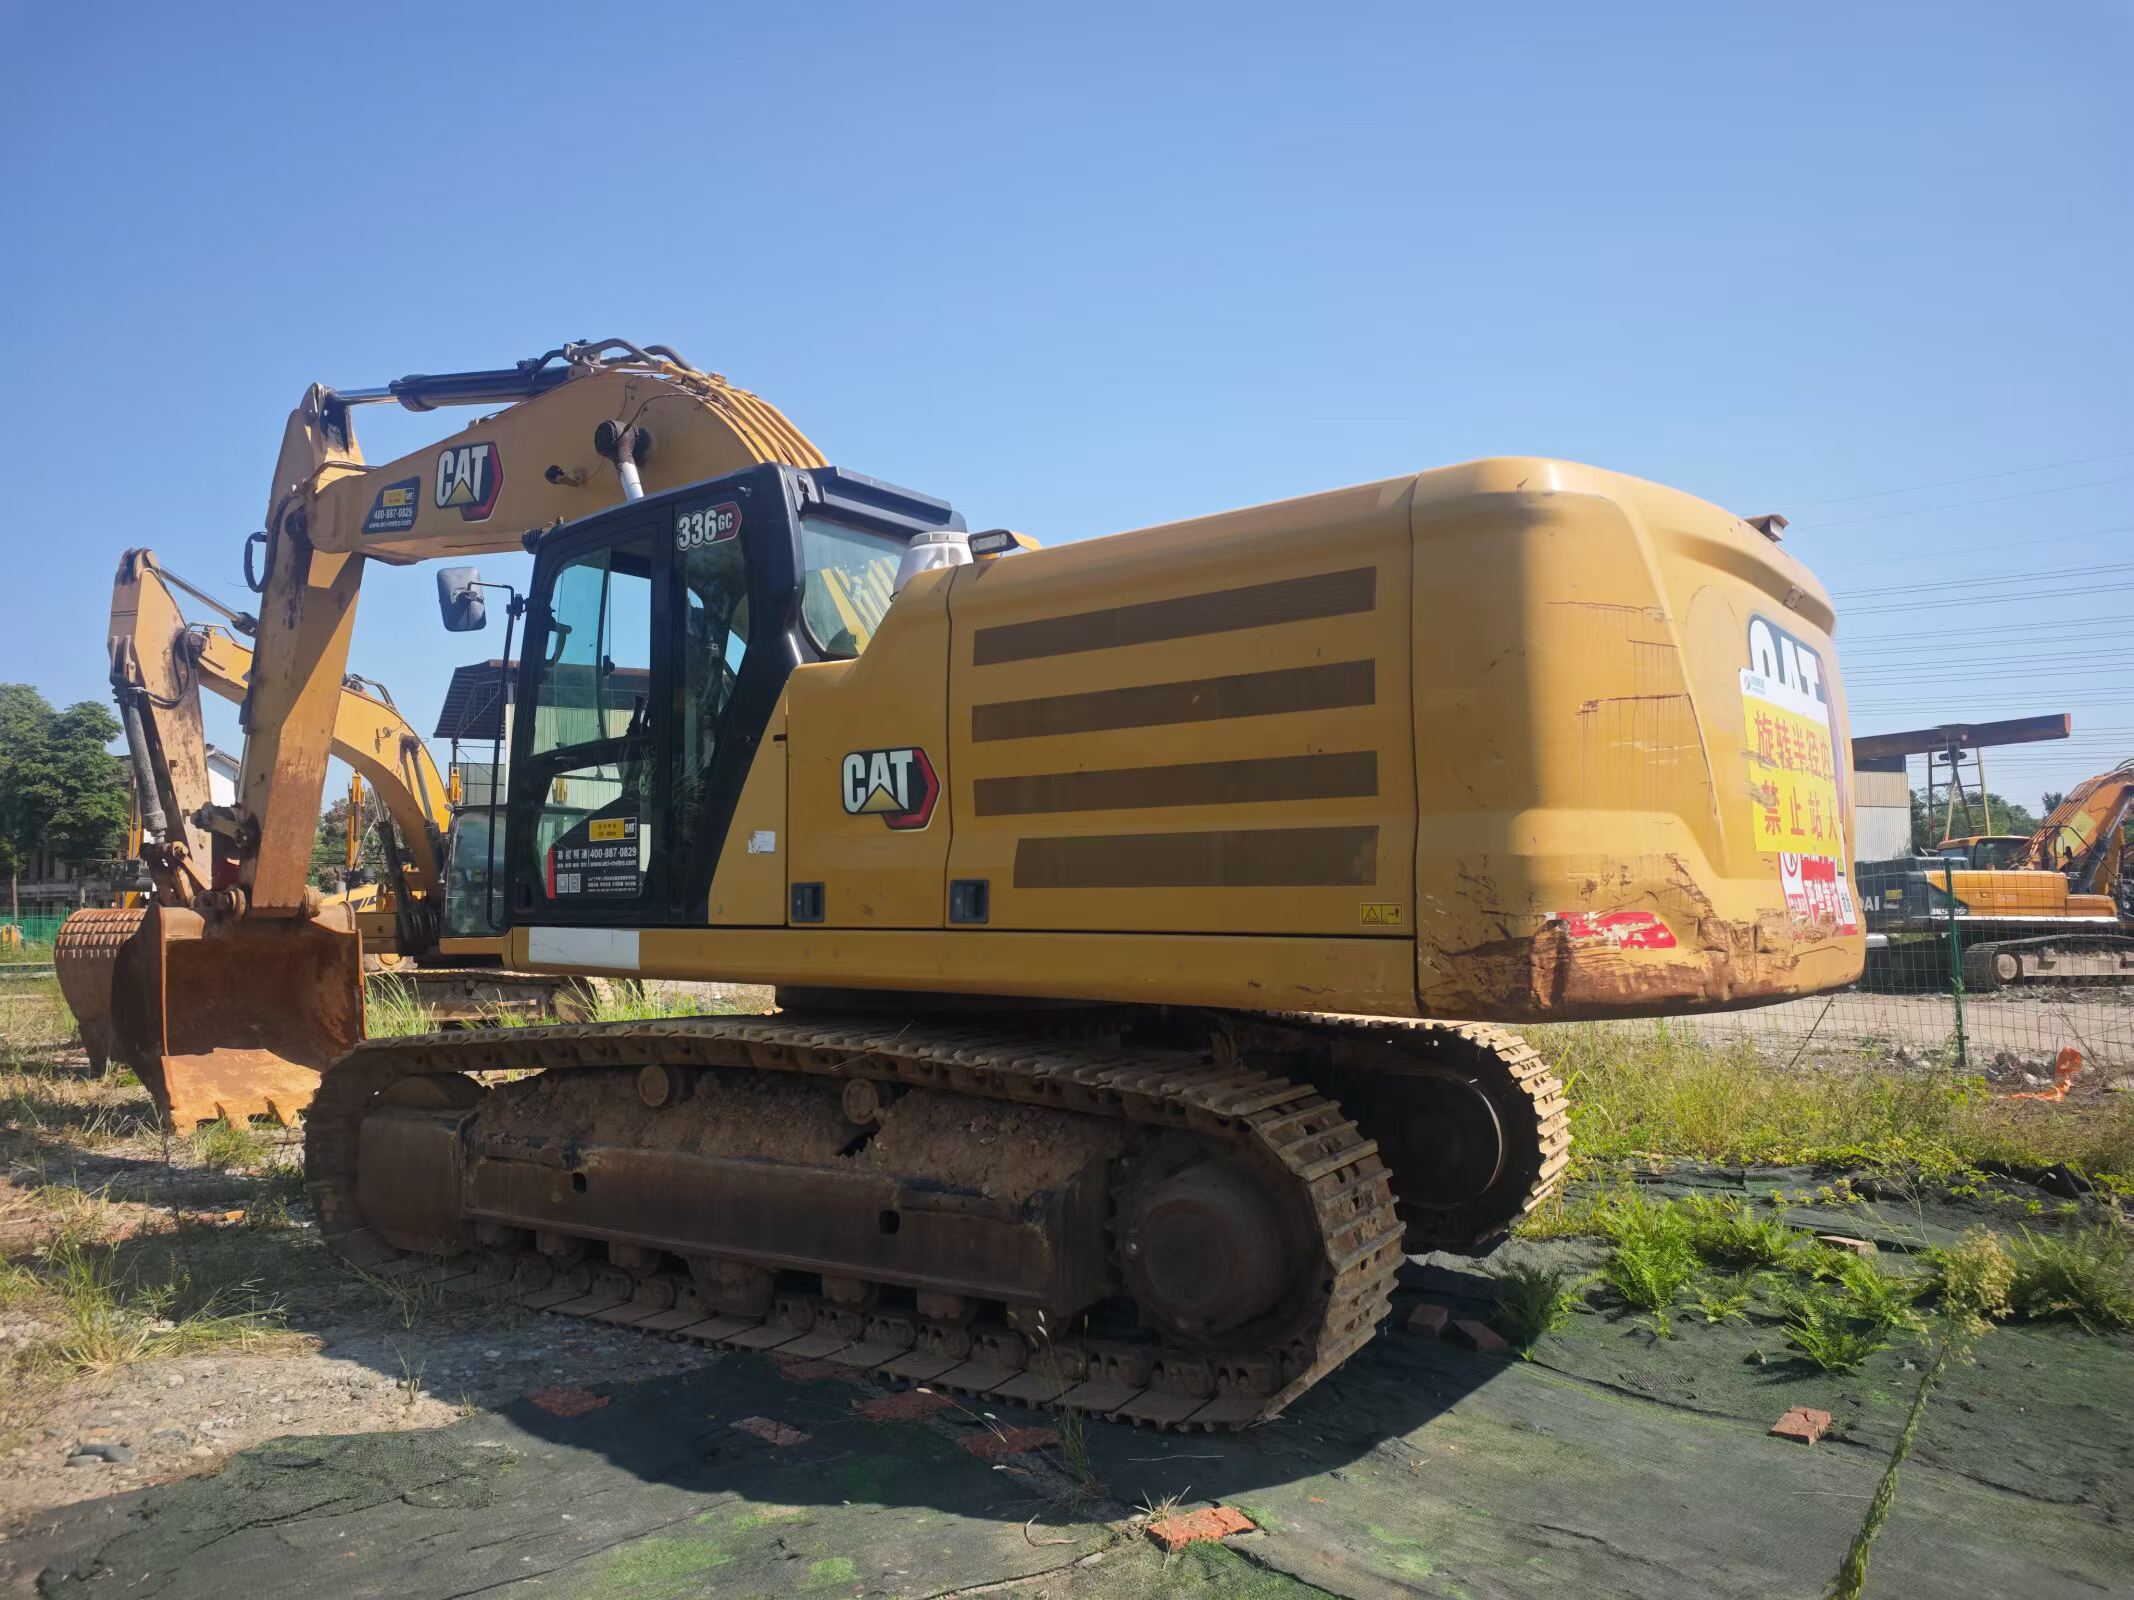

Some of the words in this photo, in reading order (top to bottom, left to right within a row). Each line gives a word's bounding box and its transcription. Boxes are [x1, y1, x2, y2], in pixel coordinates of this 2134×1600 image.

[437, 445, 488, 506] CAT
[843, 750, 913, 813] CAT
[1761, 779, 1838, 843] 禁止站人
[590, 847, 637, 858] 400-887-0829
